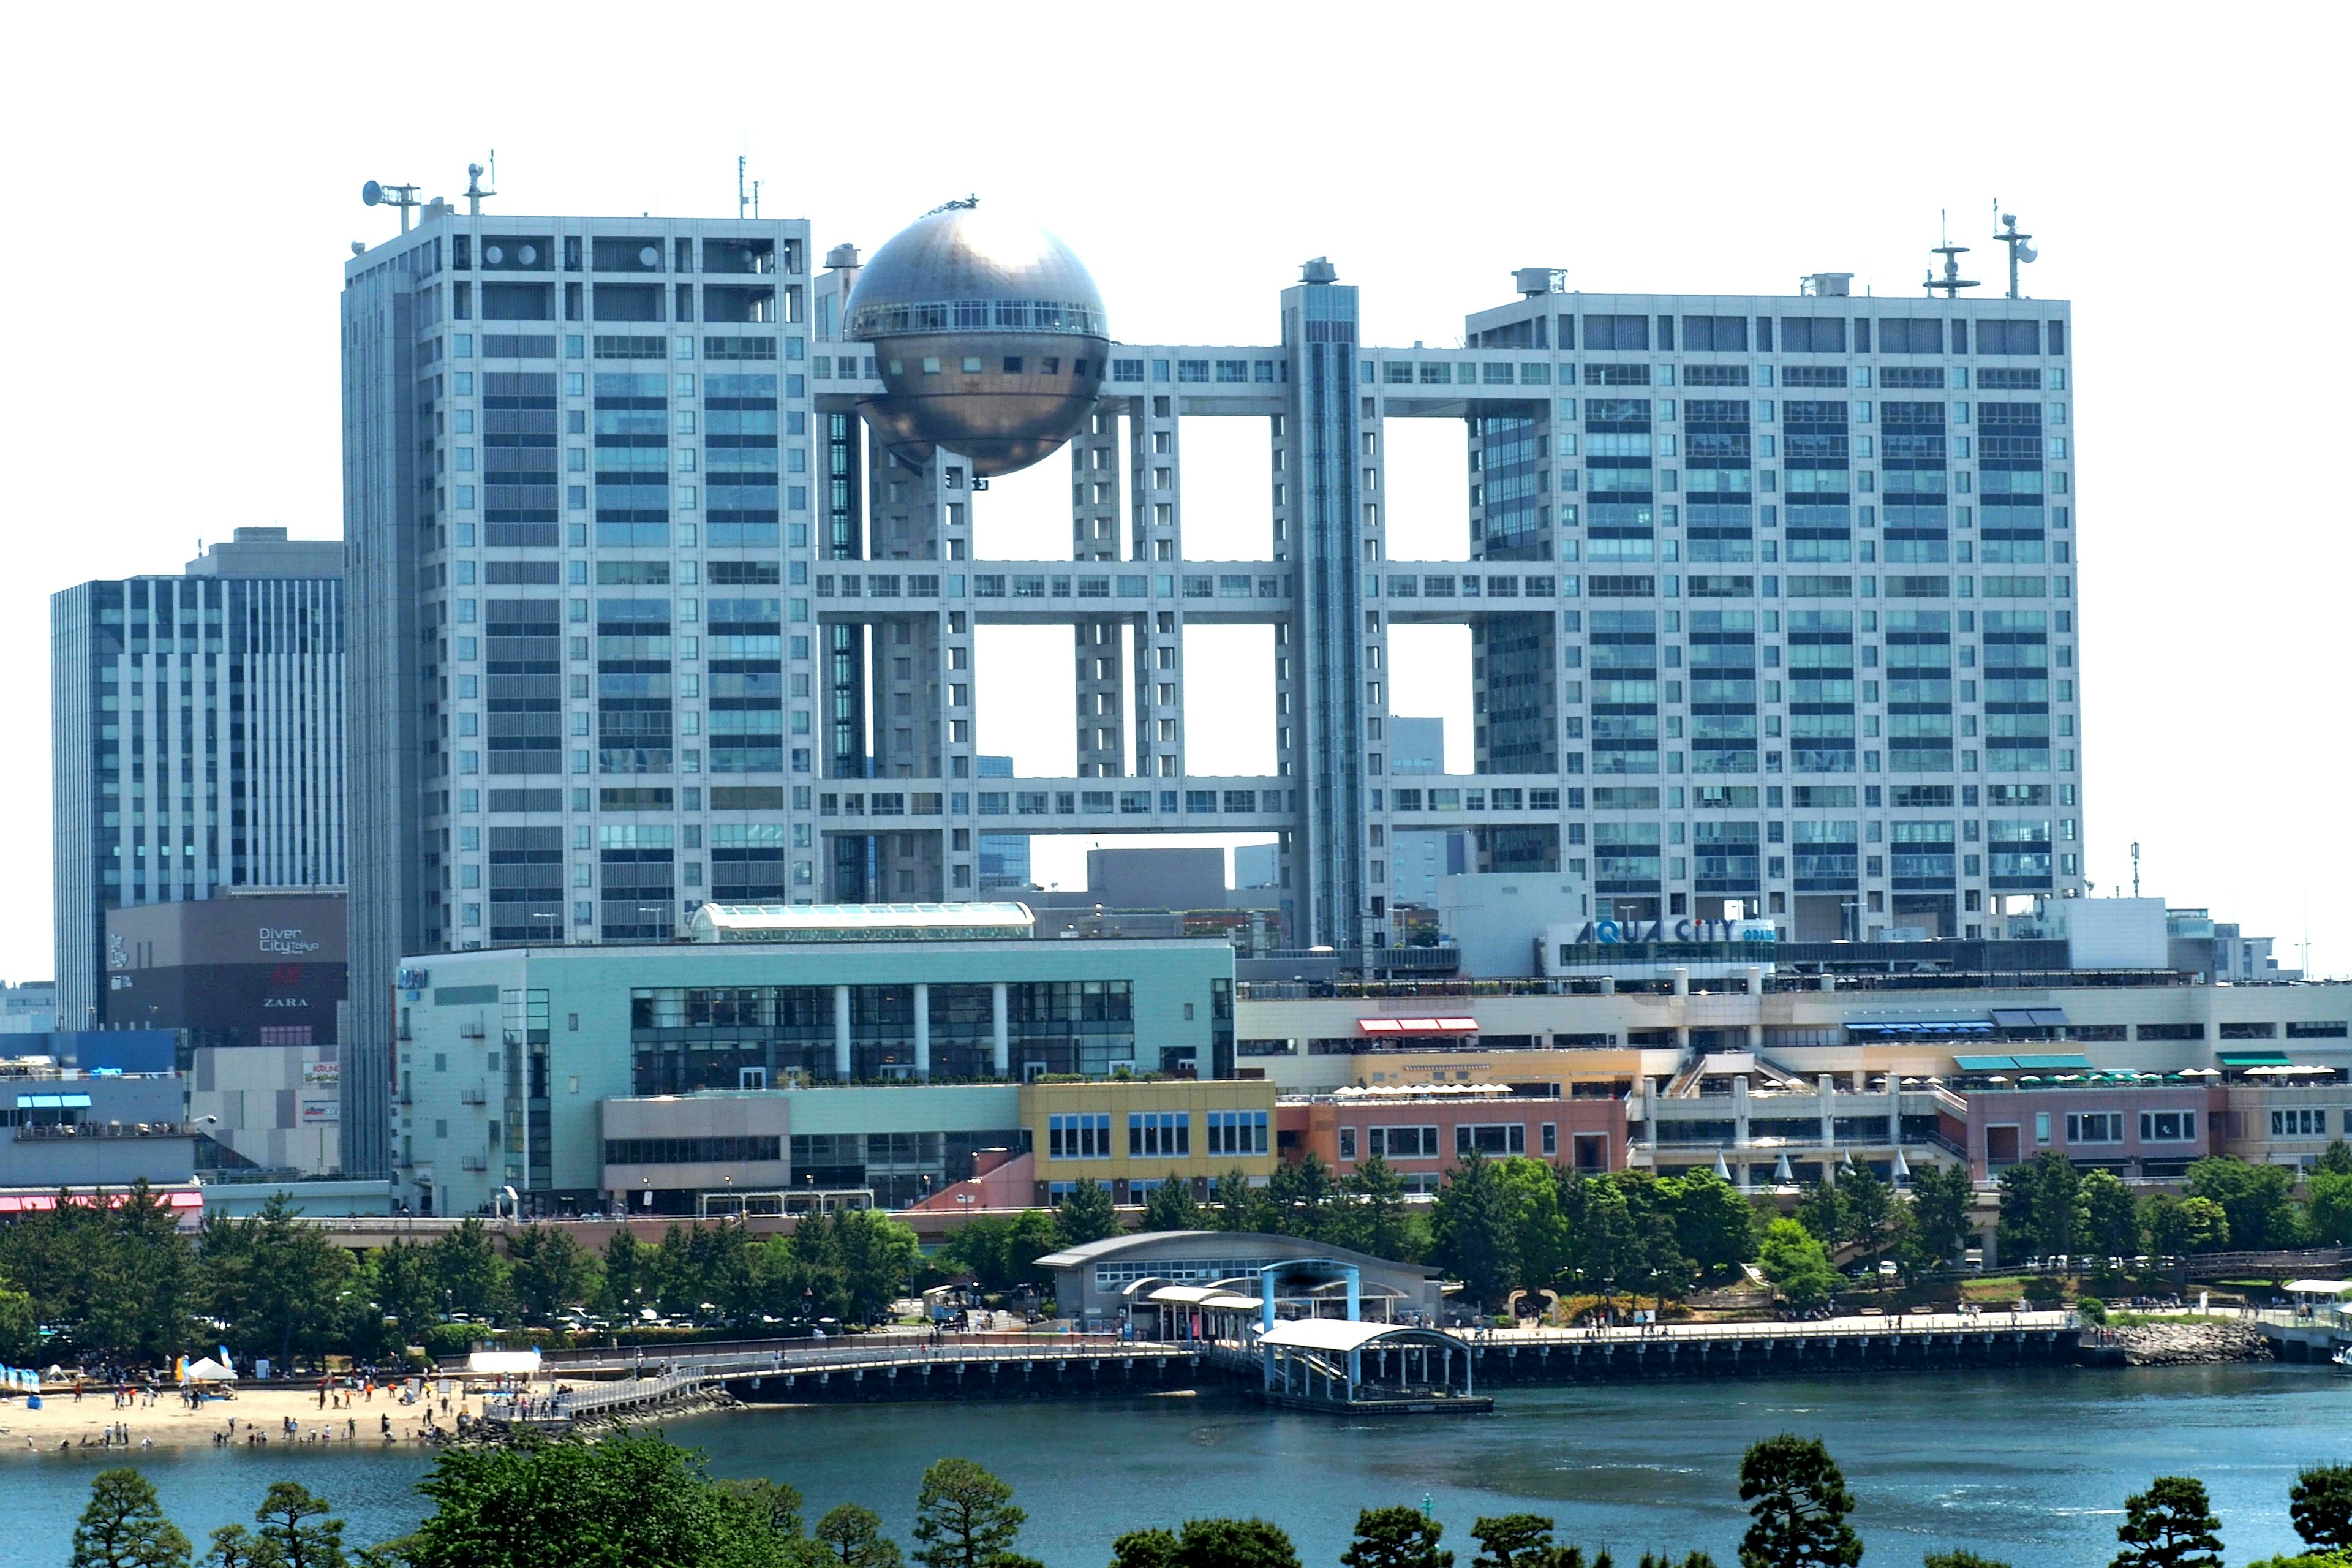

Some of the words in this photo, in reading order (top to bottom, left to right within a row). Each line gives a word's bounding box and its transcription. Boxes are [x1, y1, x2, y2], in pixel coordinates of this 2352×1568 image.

[260, 928, 301, 939] Diver
[1575, 920, 1663, 943] AQUA
[260, 940, 290, 954] City
[264, 998, 307, 1007] ZARA
